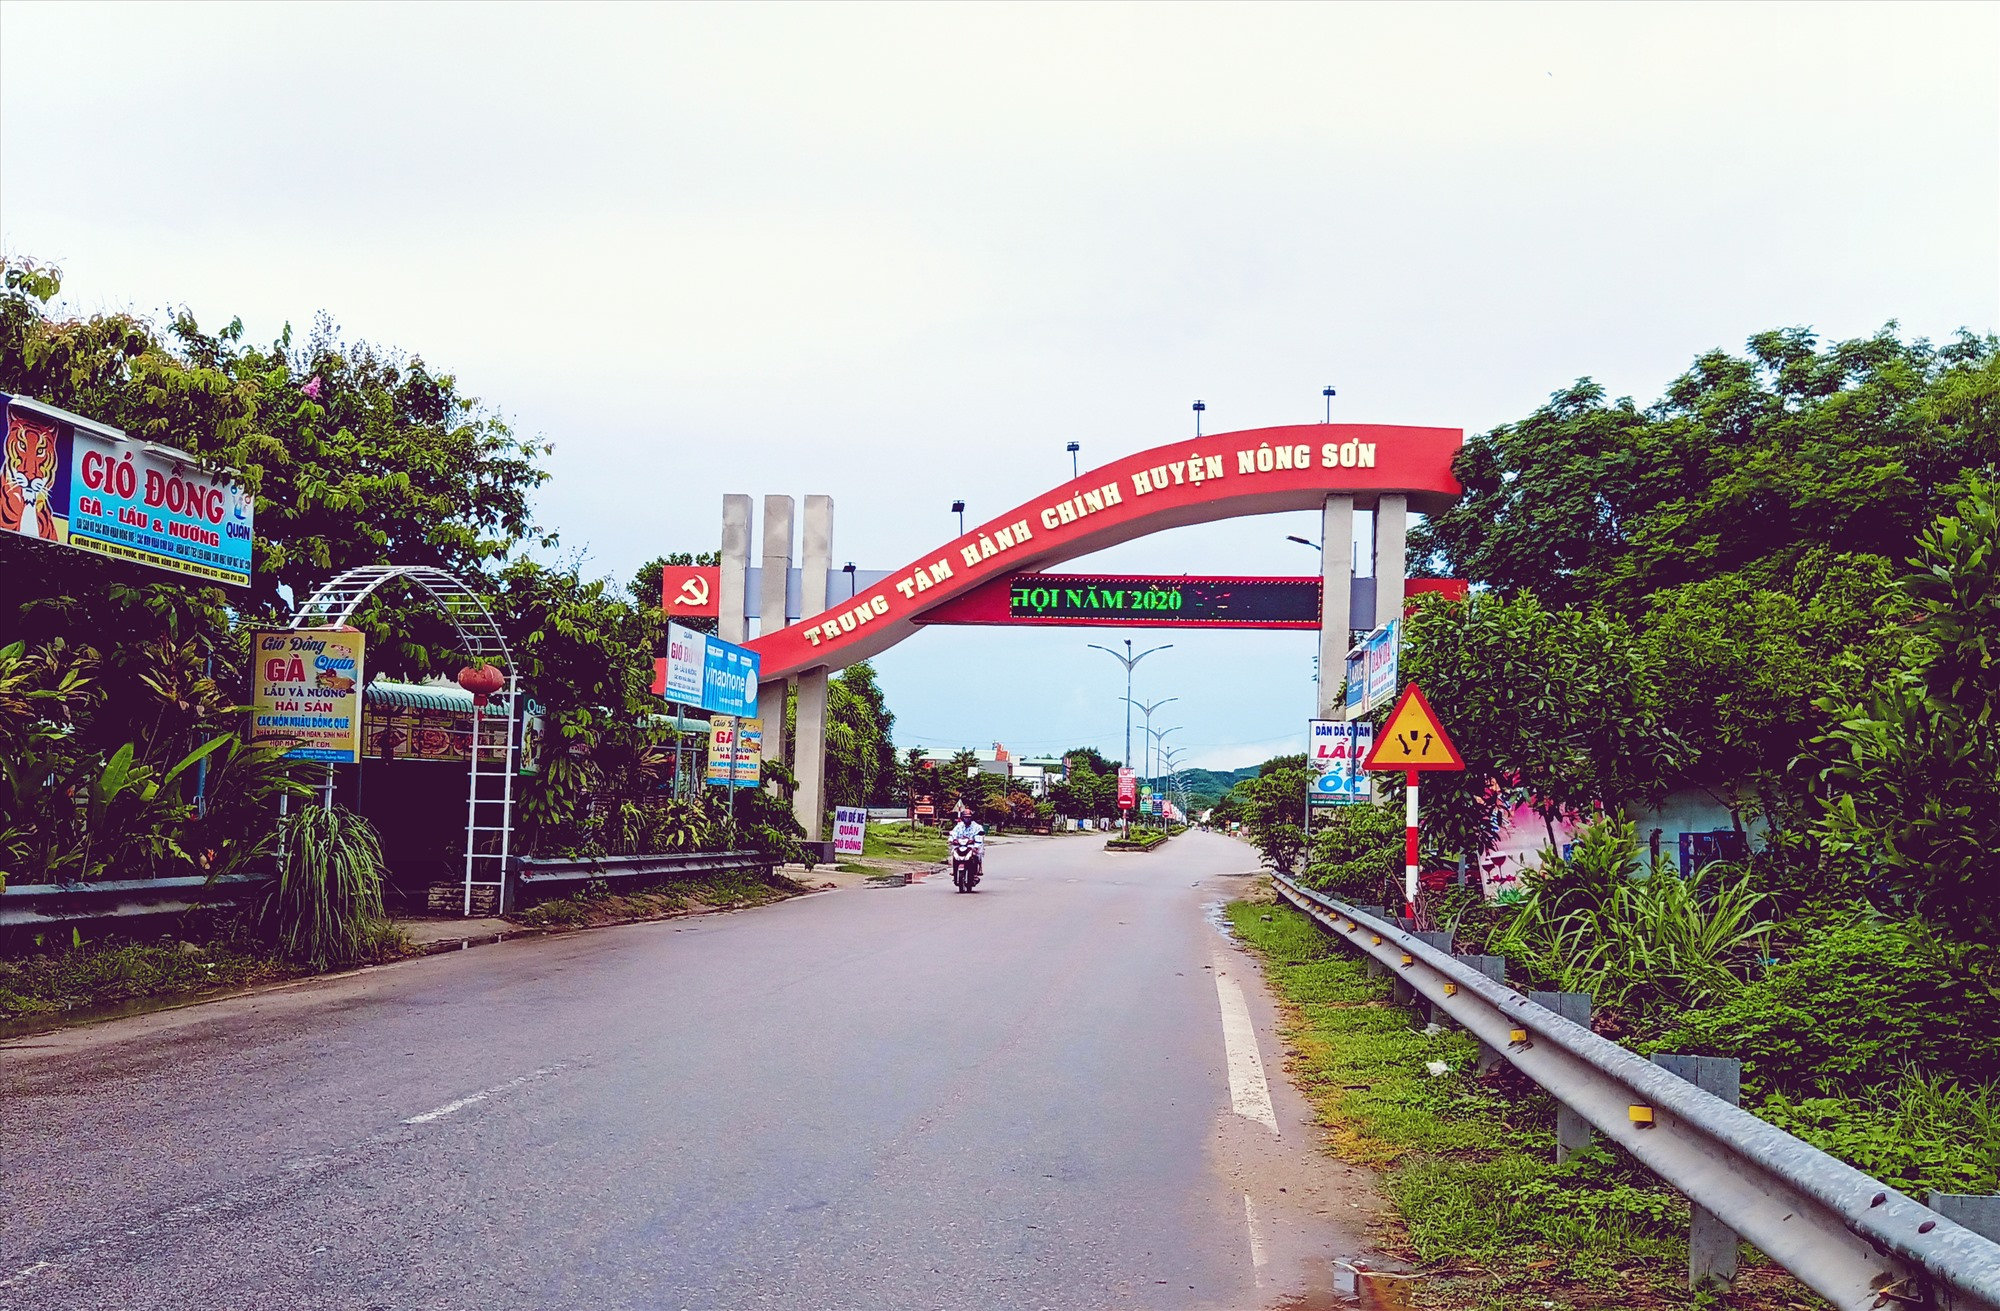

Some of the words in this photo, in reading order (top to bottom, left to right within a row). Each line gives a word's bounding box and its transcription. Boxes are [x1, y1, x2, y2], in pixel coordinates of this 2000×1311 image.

[82, 450, 136, 499] GIÓ
[80, 496, 102, 517] GÀ
[169, 521, 220, 547] NƯỚNG
[803, 594, 890, 647] TRUNG
[895, 557, 954, 599] TÂM
[960, 519, 1033, 568] HÀNH
[1040, 481, 1123, 530] CHÍNH
[1131, 452, 1224, 487] HUYỆN
[1237, 442, 1311, 475] NÔNG
[1321, 438, 1376, 468] SƠN
[1065, 585, 1125, 610] NĂM
[1131, 590, 1183, 611] 2020
[261, 636, 286, 651] Gió
[289, 635, 327, 656] Đồng
[671, 641, 683, 661] GIÓ
[266, 654, 306, 682] GÀ
[705, 662, 745, 693] vinaphone
[264, 683, 286, 697] LẨU
[288, 686, 304, 697] VÀ
[307, 686, 347, 698] NƯỚNG
[275, 699, 299, 711] HẢI
[304, 699, 333, 713] SẢN
[257, 714, 272, 727] CÁC
[1317, 738, 1366, 759] LẨU
[1318, 767, 1365, 793] ỐC
[857, 812, 865, 824] XE
[839, 824, 859, 836] QUÁN
